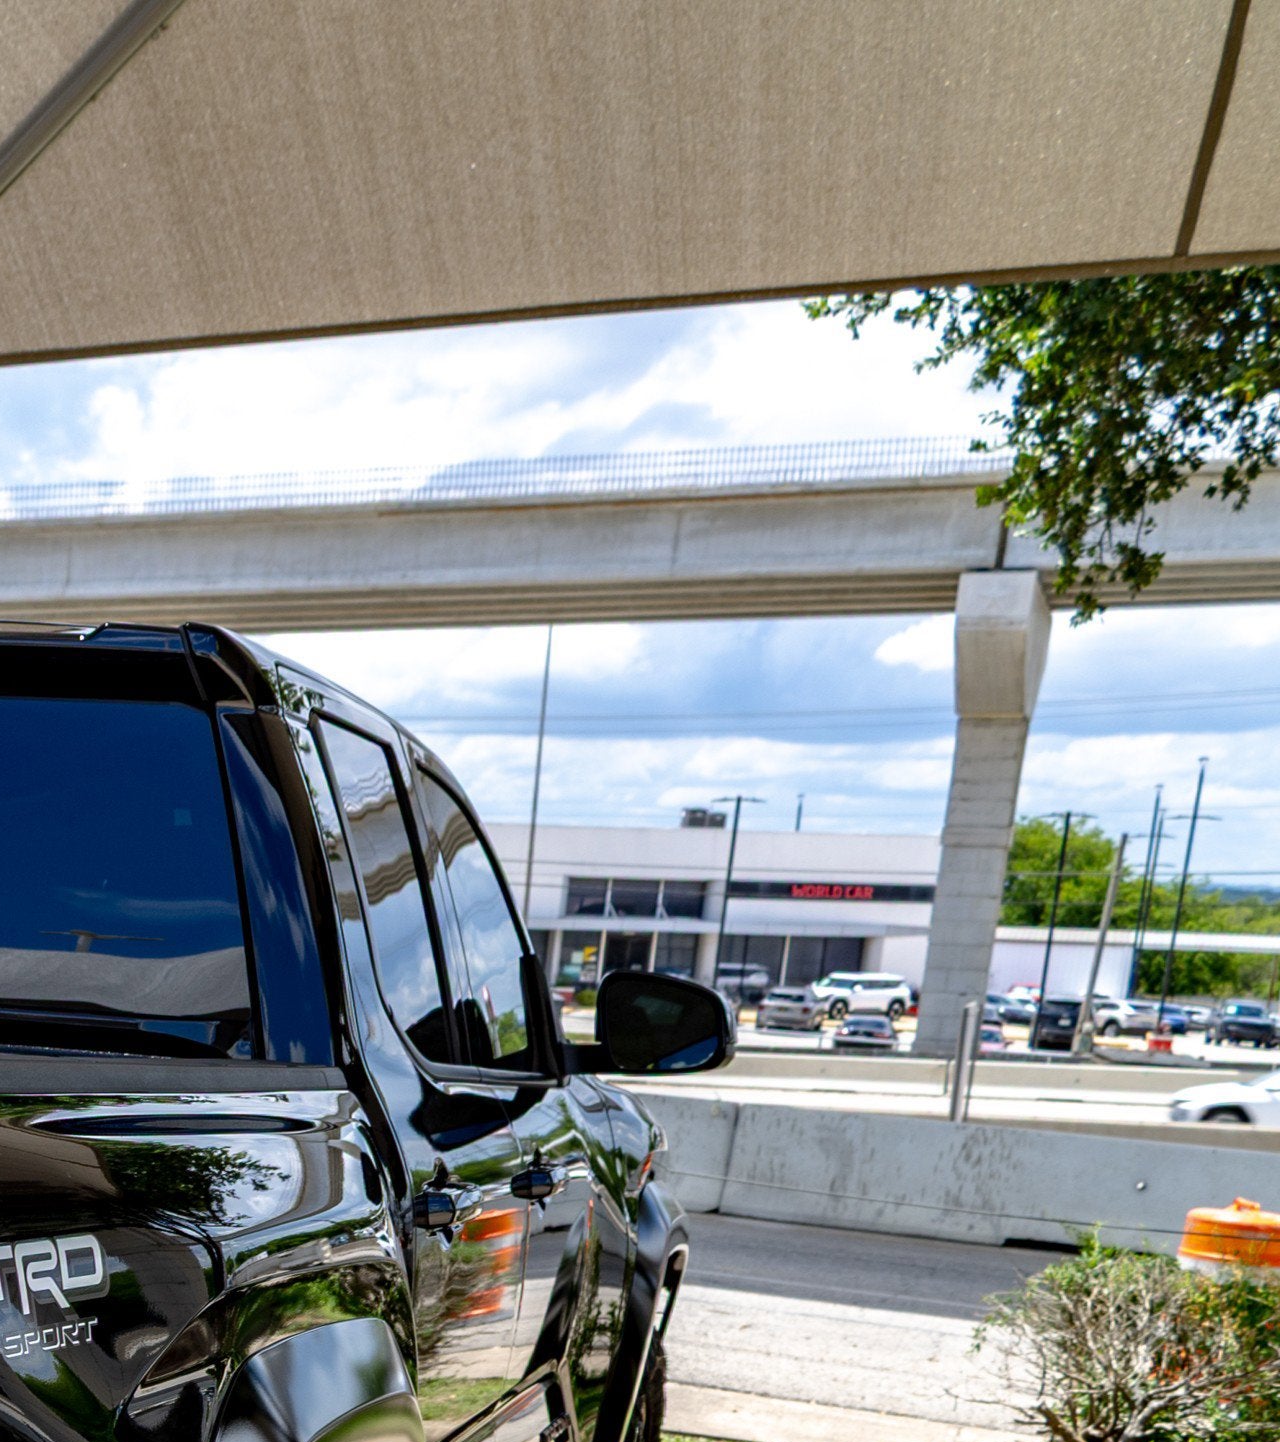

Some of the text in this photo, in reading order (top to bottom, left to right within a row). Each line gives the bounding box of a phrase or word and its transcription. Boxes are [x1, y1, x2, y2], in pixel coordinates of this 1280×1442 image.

[791, 884, 874, 899] WORLD CAR
[4, 1317, 98, 1358] SPORT
